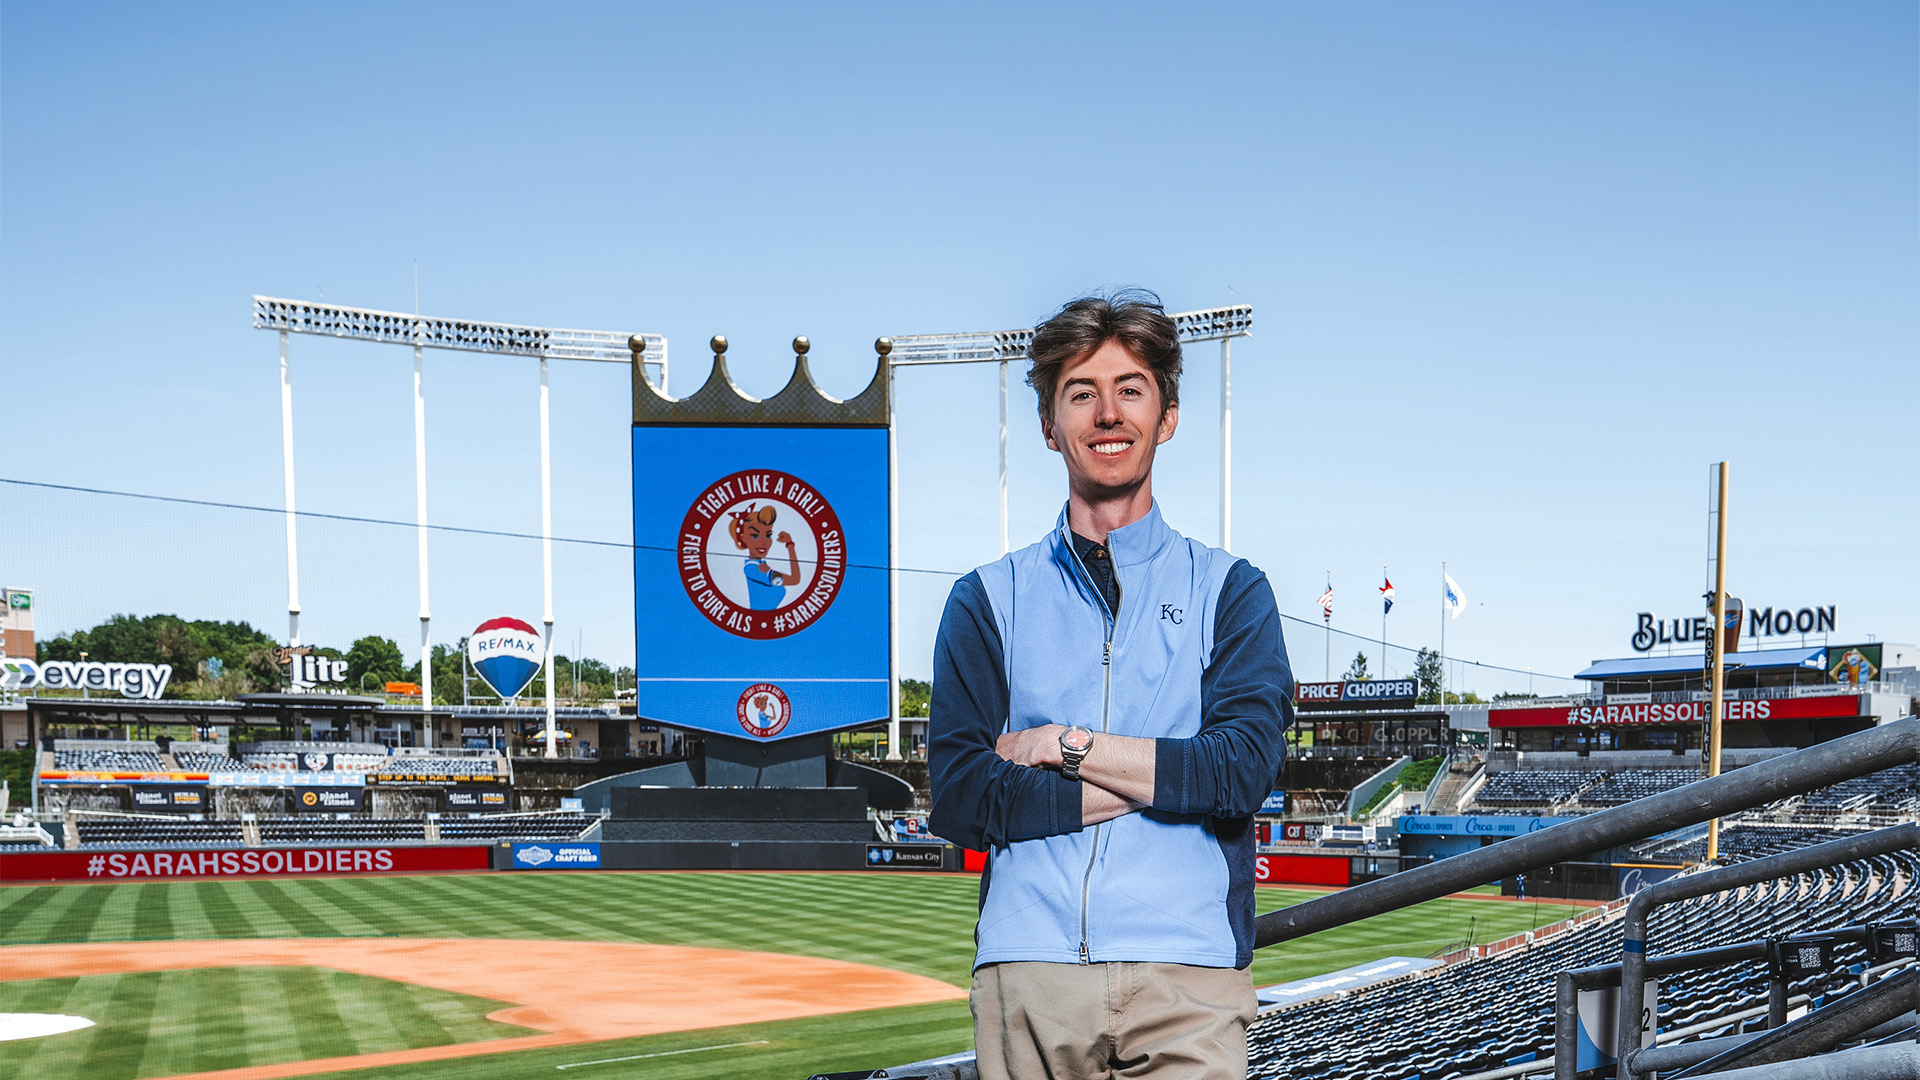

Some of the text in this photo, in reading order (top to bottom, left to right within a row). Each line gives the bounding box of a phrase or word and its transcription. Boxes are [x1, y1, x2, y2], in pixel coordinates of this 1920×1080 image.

[696, 474, 825, 519] FIGHT LIKE A GIRL!
[682, 533, 752, 633] FIGHT TO CURE ALS
[773, 530, 842, 633] #SARAHSSOLDIERS
[1160, 603, 1183, 625] KC
[1749, 605, 1836, 638] MOON
[478, 637, 535, 653] RE/MAX
[44, 665, 167, 697] evergy
[289, 653, 349, 689] Lite
[1299, 681, 1414, 699] PRICE CHOPPER
[1703, 629, 1714, 761] ROOT 4 CHIKIN
[1567, 700, 1771, 725] #SARAHSSOLIERS
[319, 791, 350, 801] planet
[1287, 826, 1302, 838] QT
[1404, 816, 1431, 833] Circa
[1465, 818, 1494, 834] Circa
[87, 849, 394, 877] #SARAHSSOLDIERS
[896, 852, 939, 862] Kansas City
